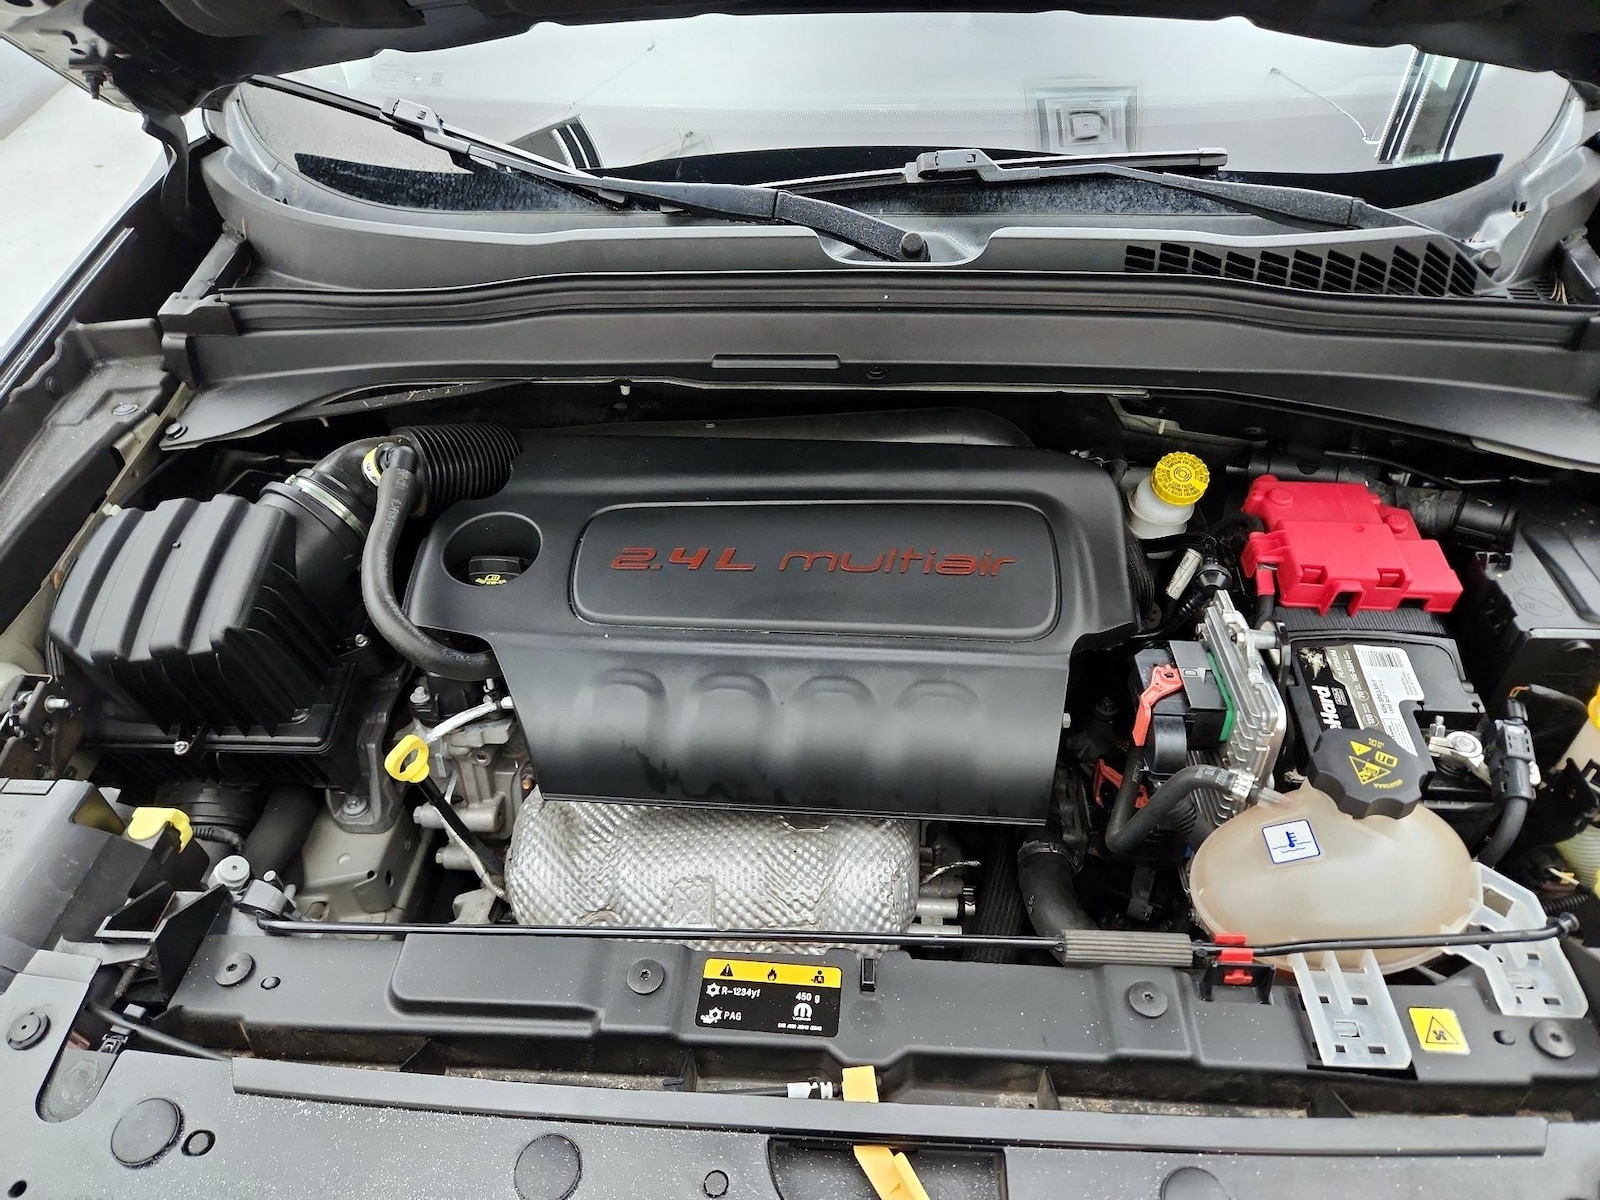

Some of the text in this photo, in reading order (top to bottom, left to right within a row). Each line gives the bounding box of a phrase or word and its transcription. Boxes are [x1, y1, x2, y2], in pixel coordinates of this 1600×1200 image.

[778, 546, 1017, 576] multiair
[721, 986, 761, 999] R-1234yf
[795, 991, 821, 1005] 450 g
[723, 1010, 742, 1021] PAG
